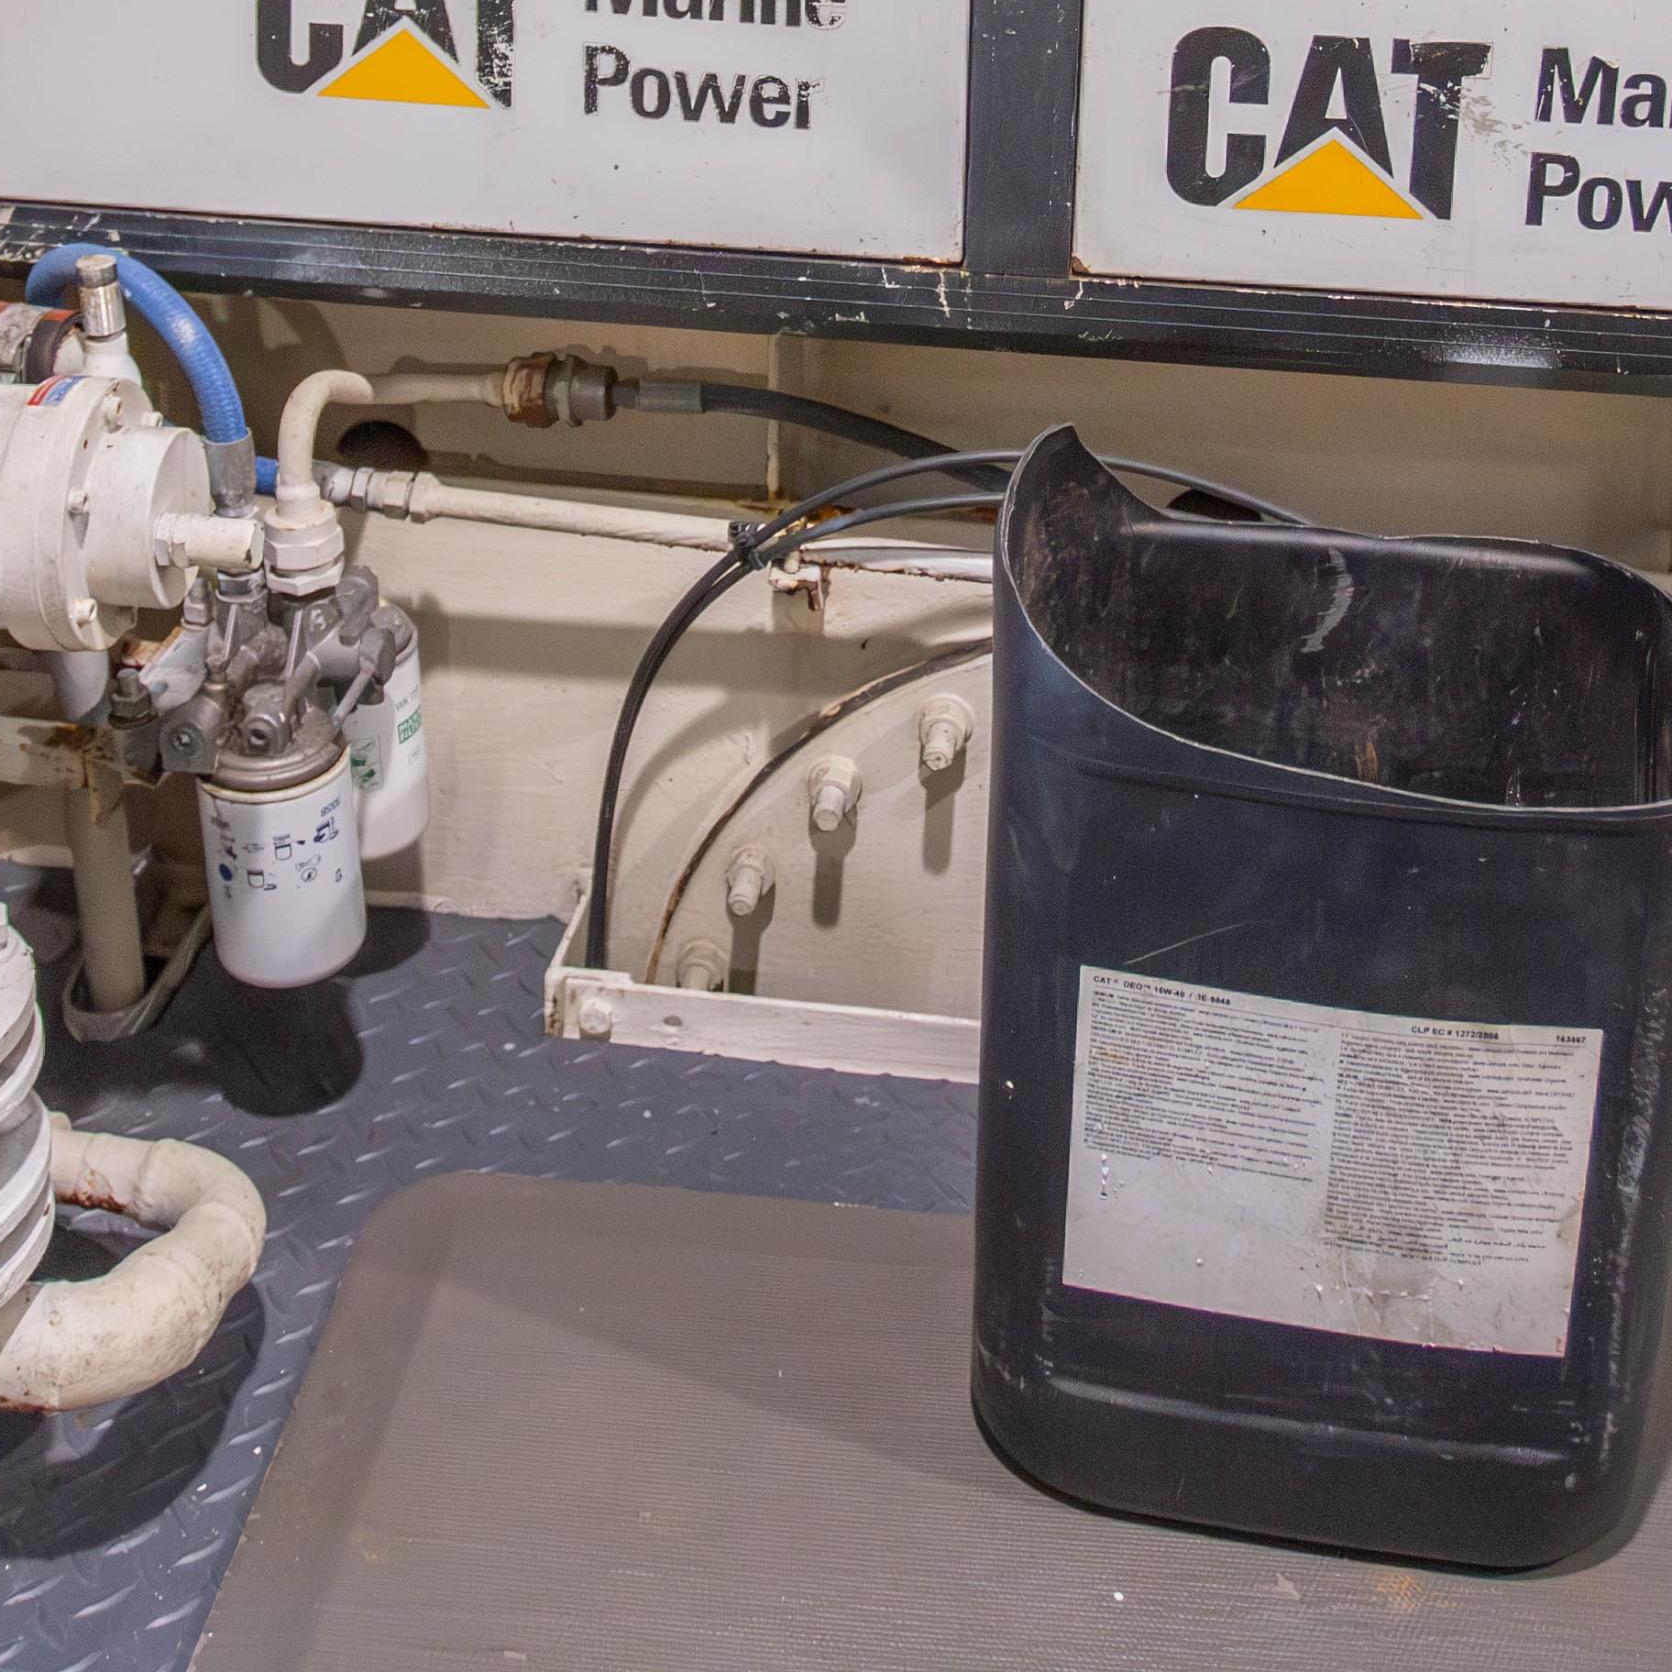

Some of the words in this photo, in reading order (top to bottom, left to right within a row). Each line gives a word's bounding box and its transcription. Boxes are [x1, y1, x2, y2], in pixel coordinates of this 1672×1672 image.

[583, 41, 826, 131] Power
[1165, 26, 1494, 221] CAT
[1432, 1028, 1445, 1036] EC
